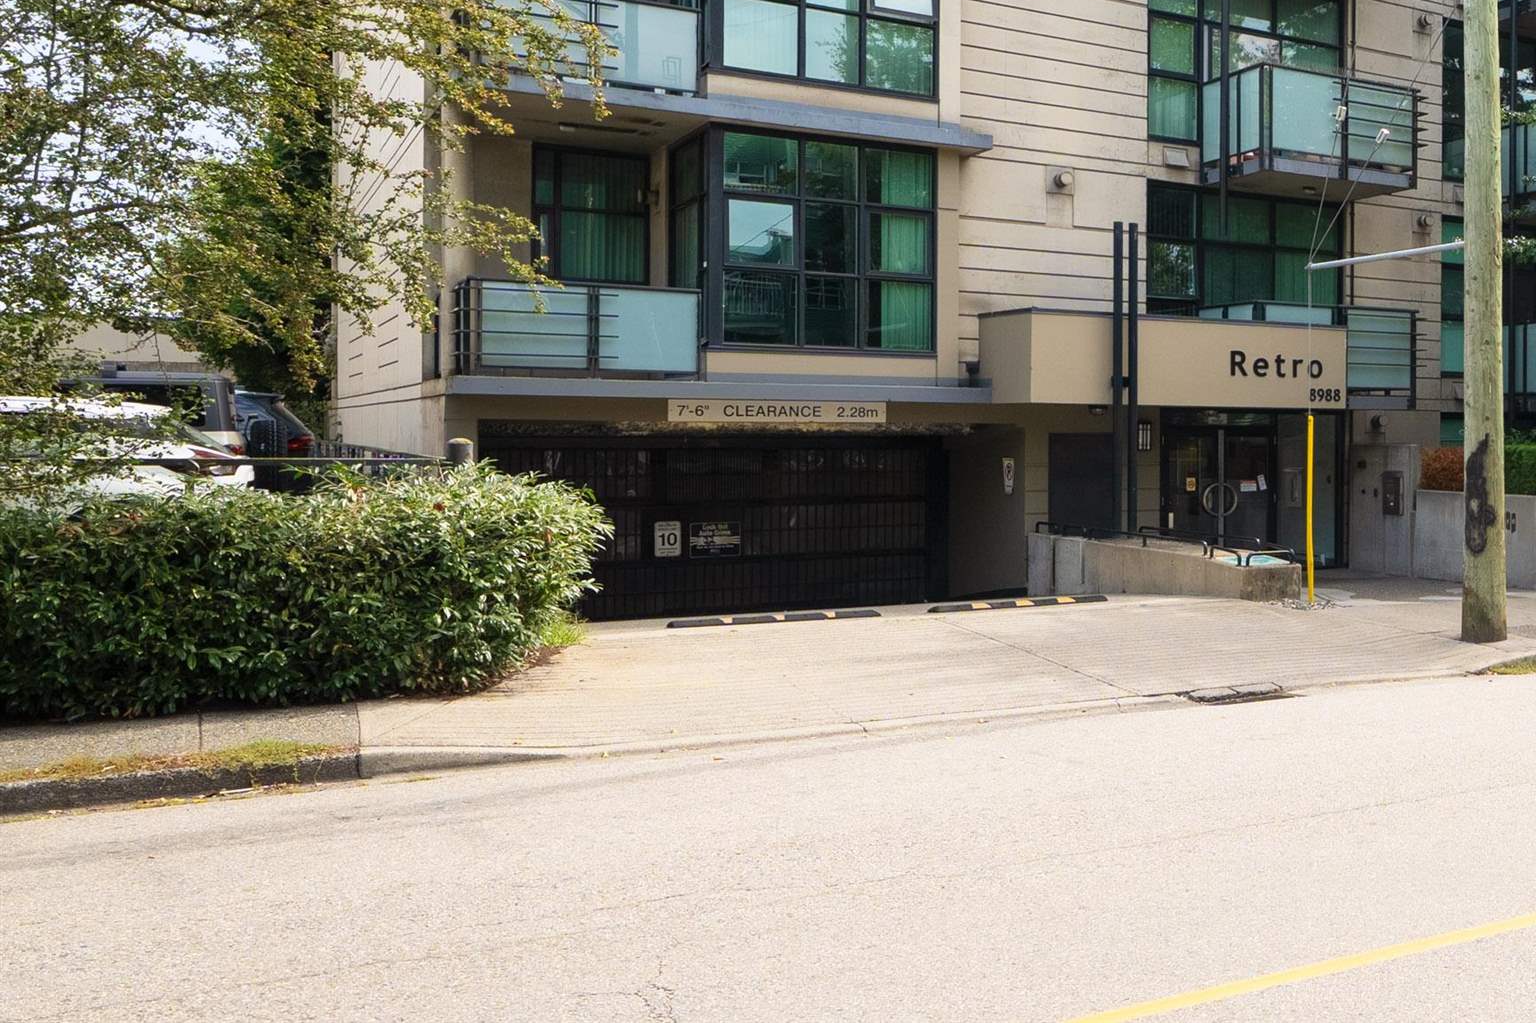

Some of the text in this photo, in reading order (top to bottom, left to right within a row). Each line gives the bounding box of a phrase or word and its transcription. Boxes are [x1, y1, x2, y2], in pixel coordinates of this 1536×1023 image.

[1230, 350, 1323, 378] Retro
[1309, 388, 1341, 402] 8988
[722, 404, 822, 418] CLEARANCE
[836, 406, 878, 418] 2.28m
[658, 532, 678, 547] 10
